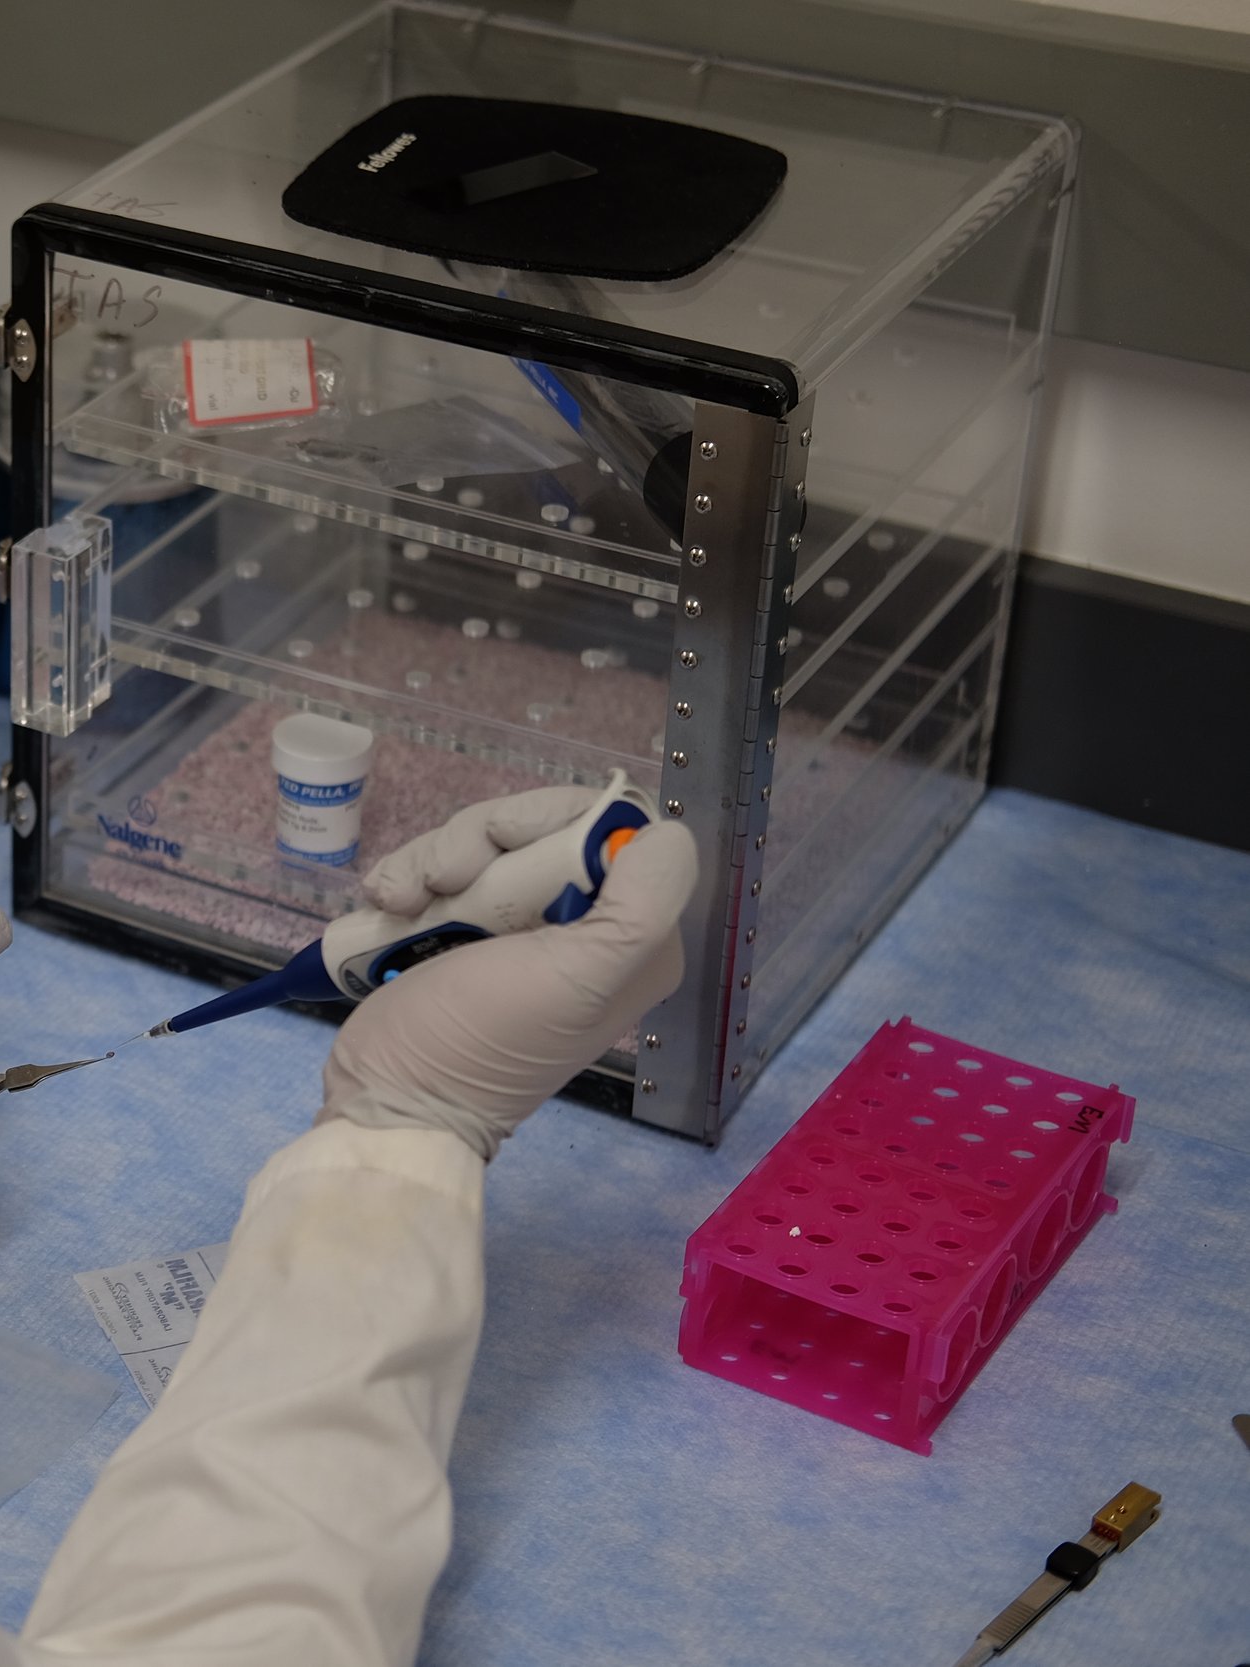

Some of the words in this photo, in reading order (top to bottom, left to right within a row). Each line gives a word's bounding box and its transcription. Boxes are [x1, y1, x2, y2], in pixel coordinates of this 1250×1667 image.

[357, 132, 417, 173] Fellowes
[281, 777, 299, 794] TED
[97, 813, 182, 860] Nalgene
